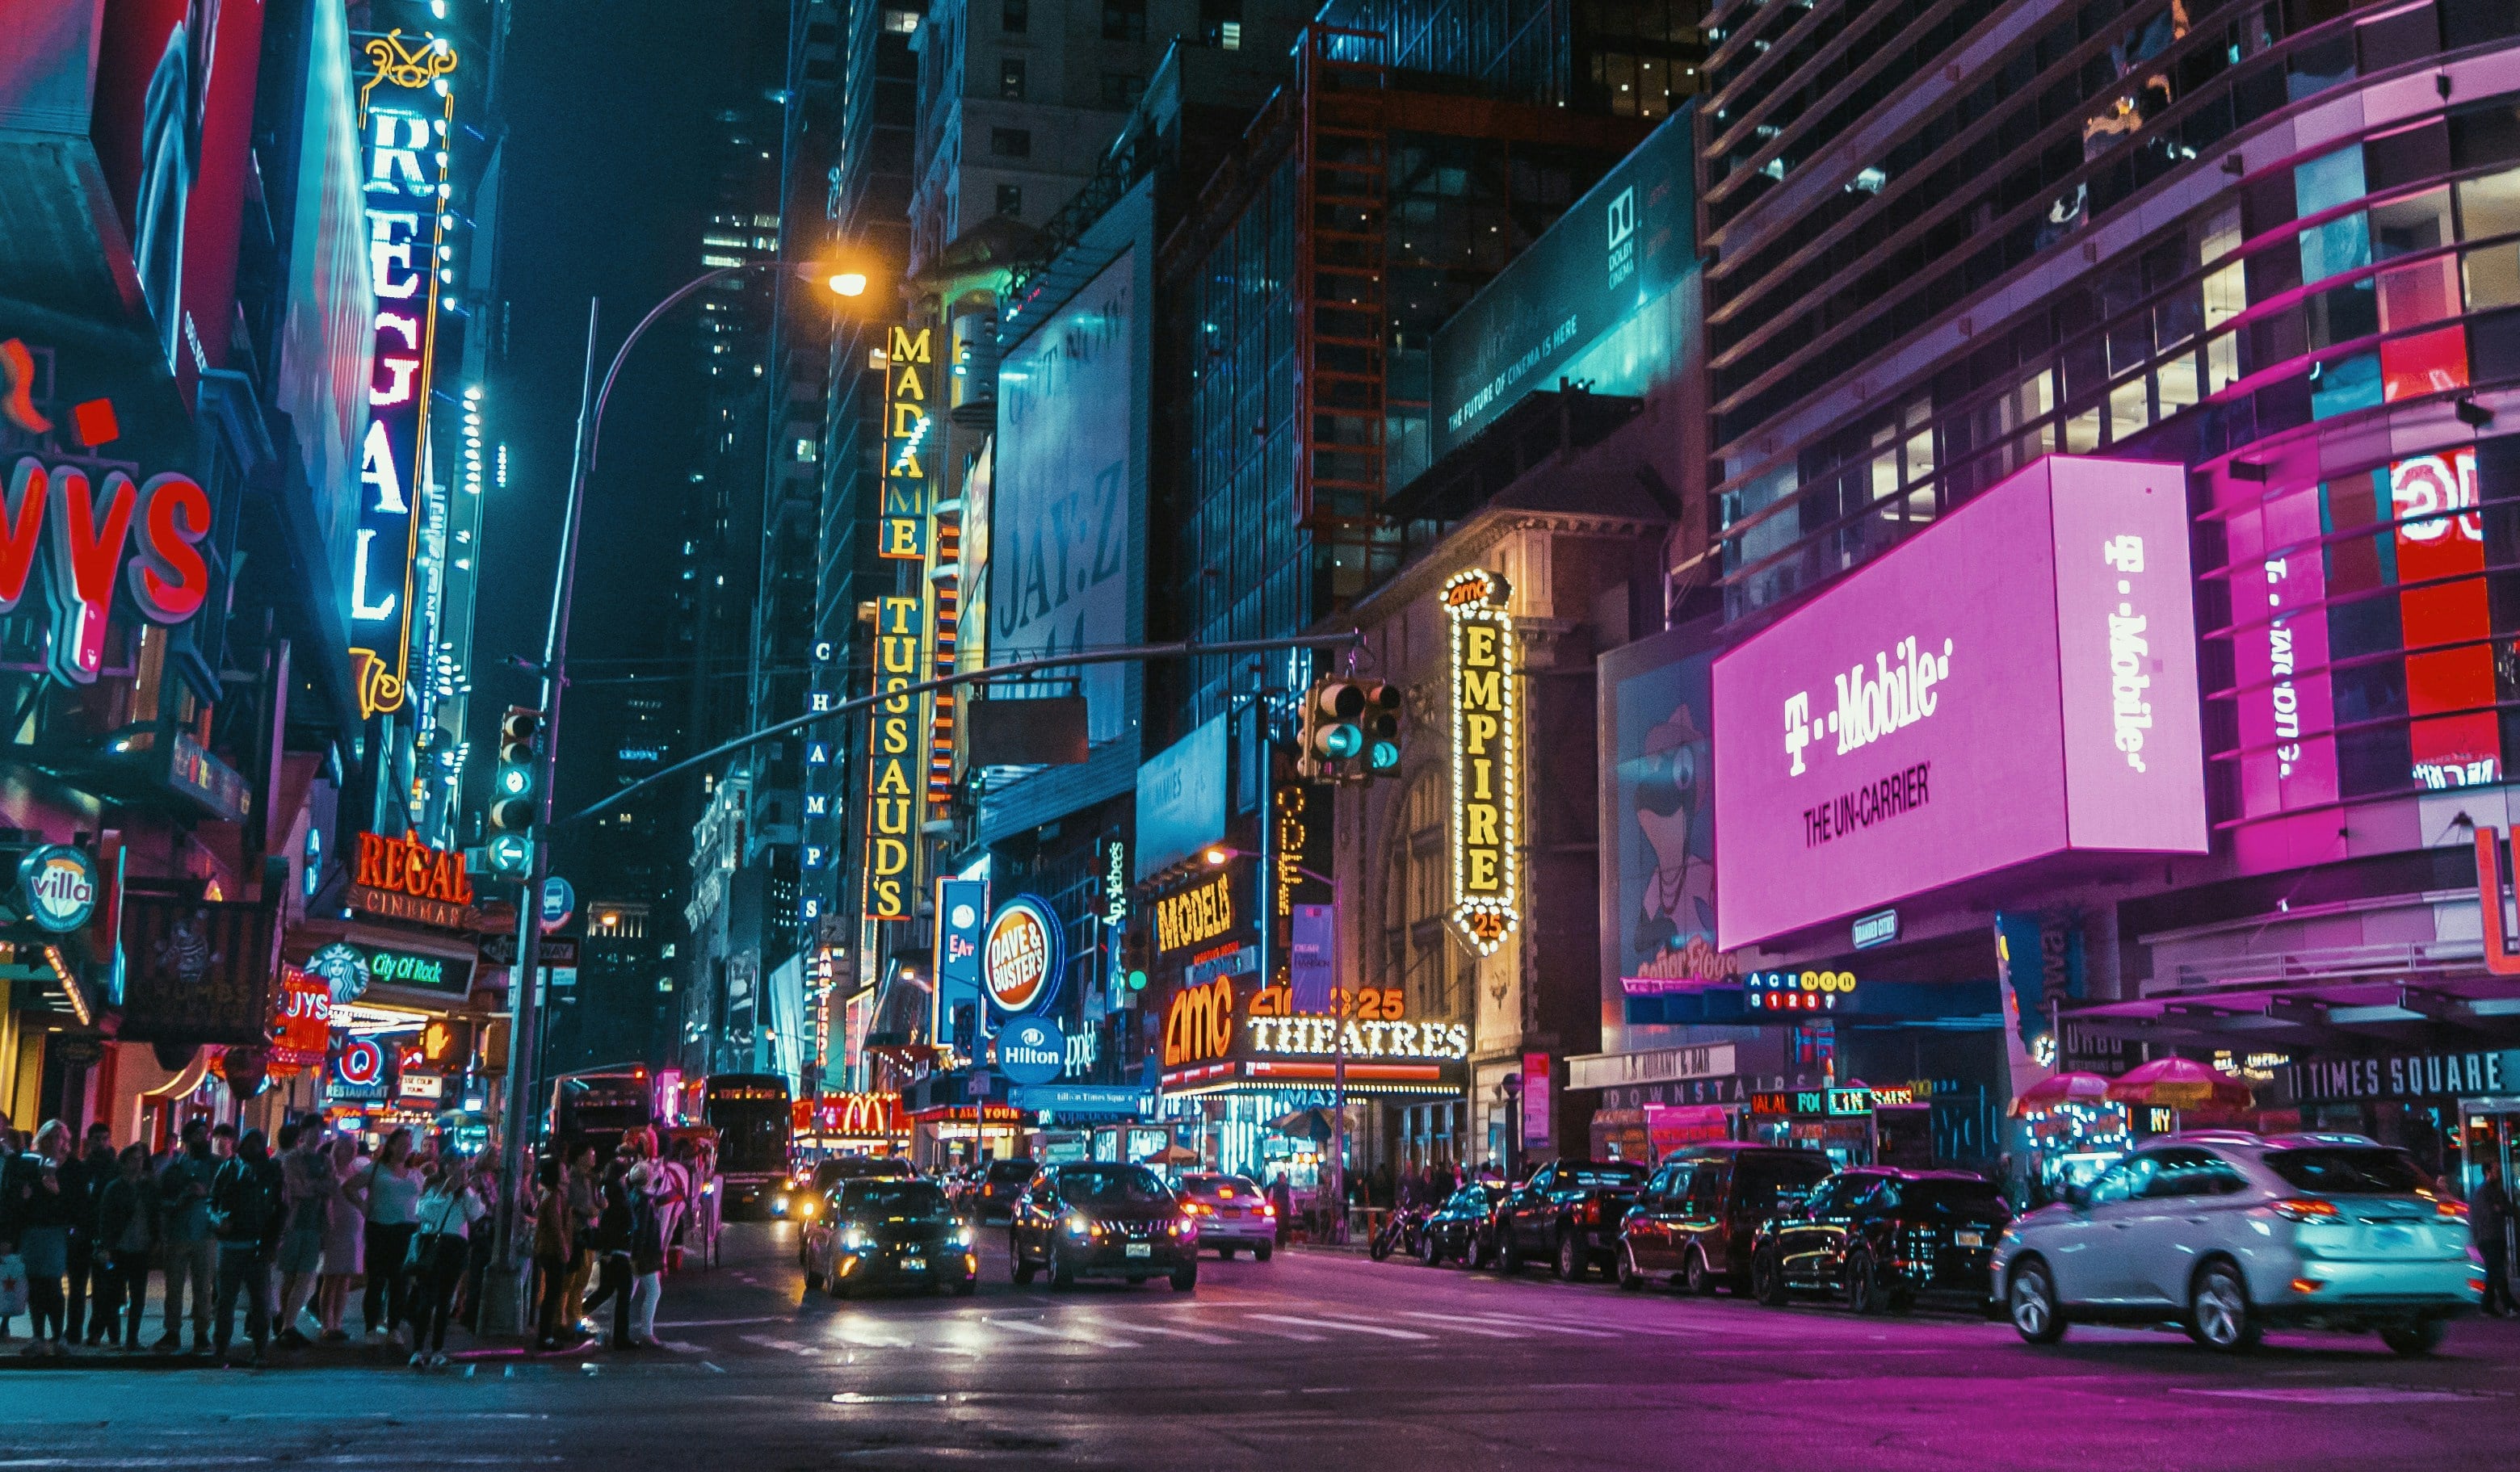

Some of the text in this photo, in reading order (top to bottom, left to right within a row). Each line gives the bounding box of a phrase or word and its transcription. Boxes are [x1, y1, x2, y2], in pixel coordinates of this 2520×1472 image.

[1609, 238, 1633, 271] DOLBY
[1609, 258, 1635, 290] CINEMA
[351, 107, 434, 619] REGAL
[1448, 314, 1577, 434] THE FUTURE OF CINEMA IS HERE
[889, 326, 930, 555] MADAME
[873, 597, 917, 916] TUSSAUD'S
[1464, 626, 1501, 890] EMPIRE
[805, 642, 831, 918] CHAMPS
[1804, 761, 1931, 849] THE UN-CARRIER
[32, 872, 92, 904] villa
[357, 831, 474, 904] REGAL
[367, 890, 460, 926] CINEMAS
[1474, 912, 1502, 938] 25
[949, 933, 975, 957] EAT
[991, 921, 1042, 968] DAVE &
[372, 953, 443, 983] City Of Rock
[992, 948, 1043, 992] BUSTER'S
[1166, 974, 1233, 1067] AMC
[1357, 988, 1405, 1021] 25
[339, 1033, 383, 1087] Q
[1005, 1046, 1059, 1065] Hilton
[1246, 1016, 1470, 1060] THEATRES
[326, 1084, 390, 1098] RESTAURANT
[1106, 1092, 1133, 1103] Squae
[2309, 1059, 2379, 1099] TIMES
[2390, 1052, 2501, 1097] SQUARE
[2150, 1107, 2170, 1132] NY
